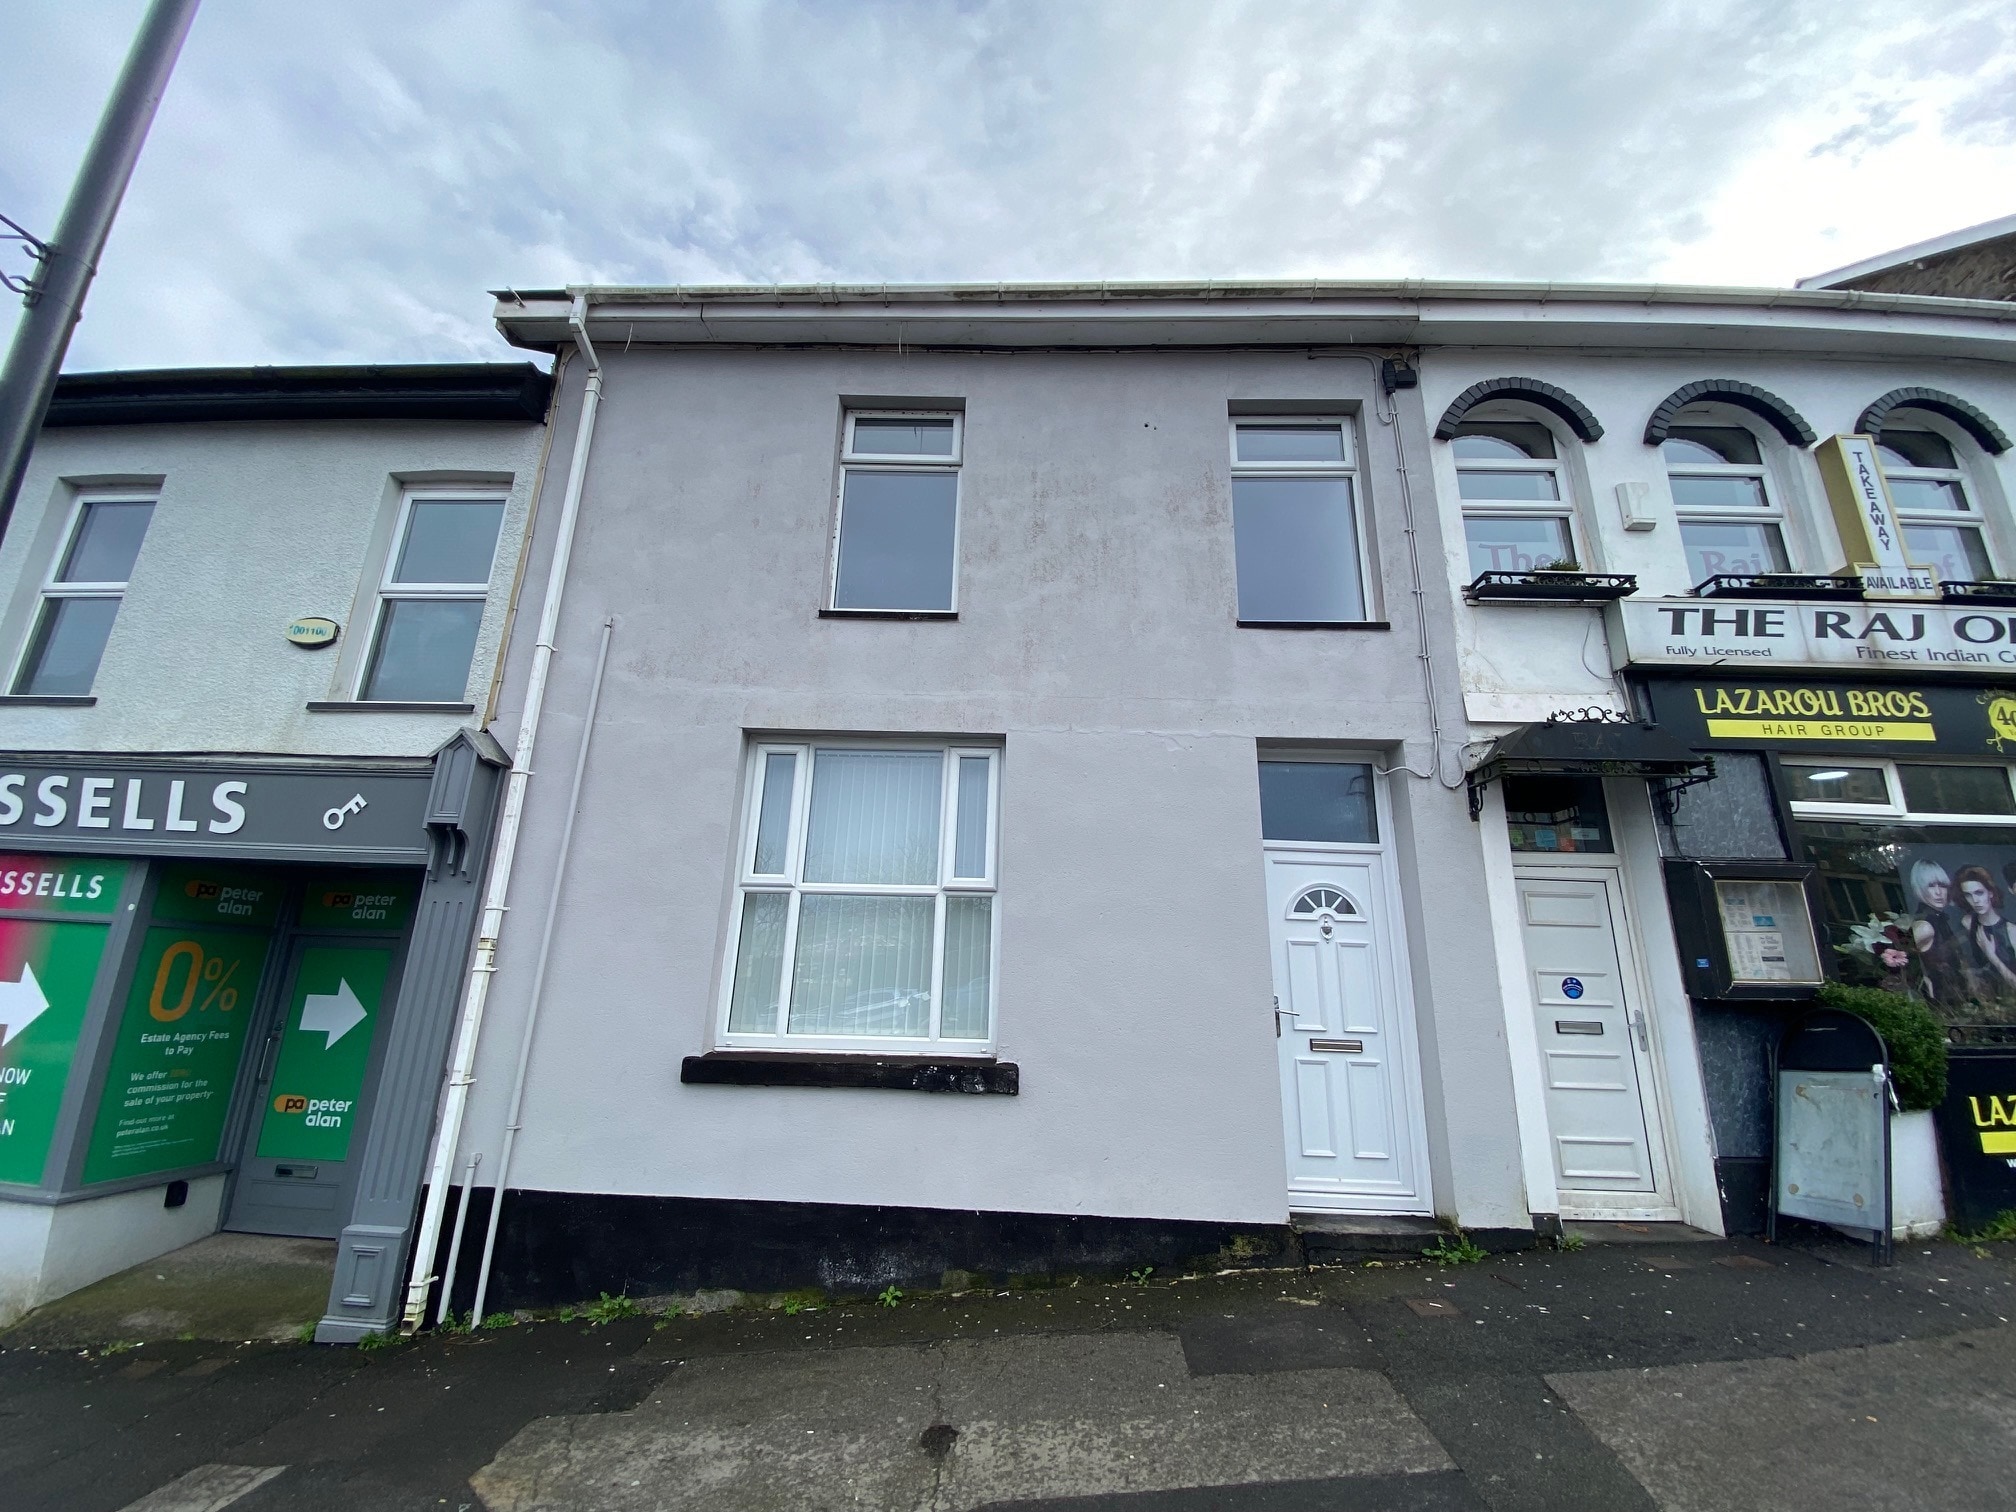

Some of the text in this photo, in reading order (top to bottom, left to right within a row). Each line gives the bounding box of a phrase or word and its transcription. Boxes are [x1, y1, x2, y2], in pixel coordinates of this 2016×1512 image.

[1853, 452, 1890, 550] TAKEAWAY
[1866, 577, 1934, 589] AVAILABLE
[1658, 608, 1785, 637] THE
[1814, 611, 1925, 641] RAJ
[1666, 646, 1772, 656] Fully Licensed
[1856, 646, 1918, 660] Finest
[1926, 649, 1990, 662] Indian
[1694, 688, 1932, 717] LAZAROU BROS
[1762, 724, 1885, 736] HAIR GROUP
[0, 871, 104, 899] SSELLS
[220, 886, 264, 902] peter
[354, 894, 396, 908] peter
[217, 901, 253, 916] alan
[352, 907, 386, 920] alan
[149, 940, 240, 1022] 0%
[140, 1030, 230, 1043] Estate Agency Fees
[164, 1045, 194, 1056] to Pay
[130, 1072, 145, 1082] We
[146, 1070, 168, 1080] offer
[126, 1079, 209, 1095] commission for the
[123, 1097, 143, 1108] sale
[144, 1095, 155, 1106] of
[155, 1095, 175, 1105] your
[284, 1098, 352, 1114] pa peter
[305, 1111, 341, 1128] alan
